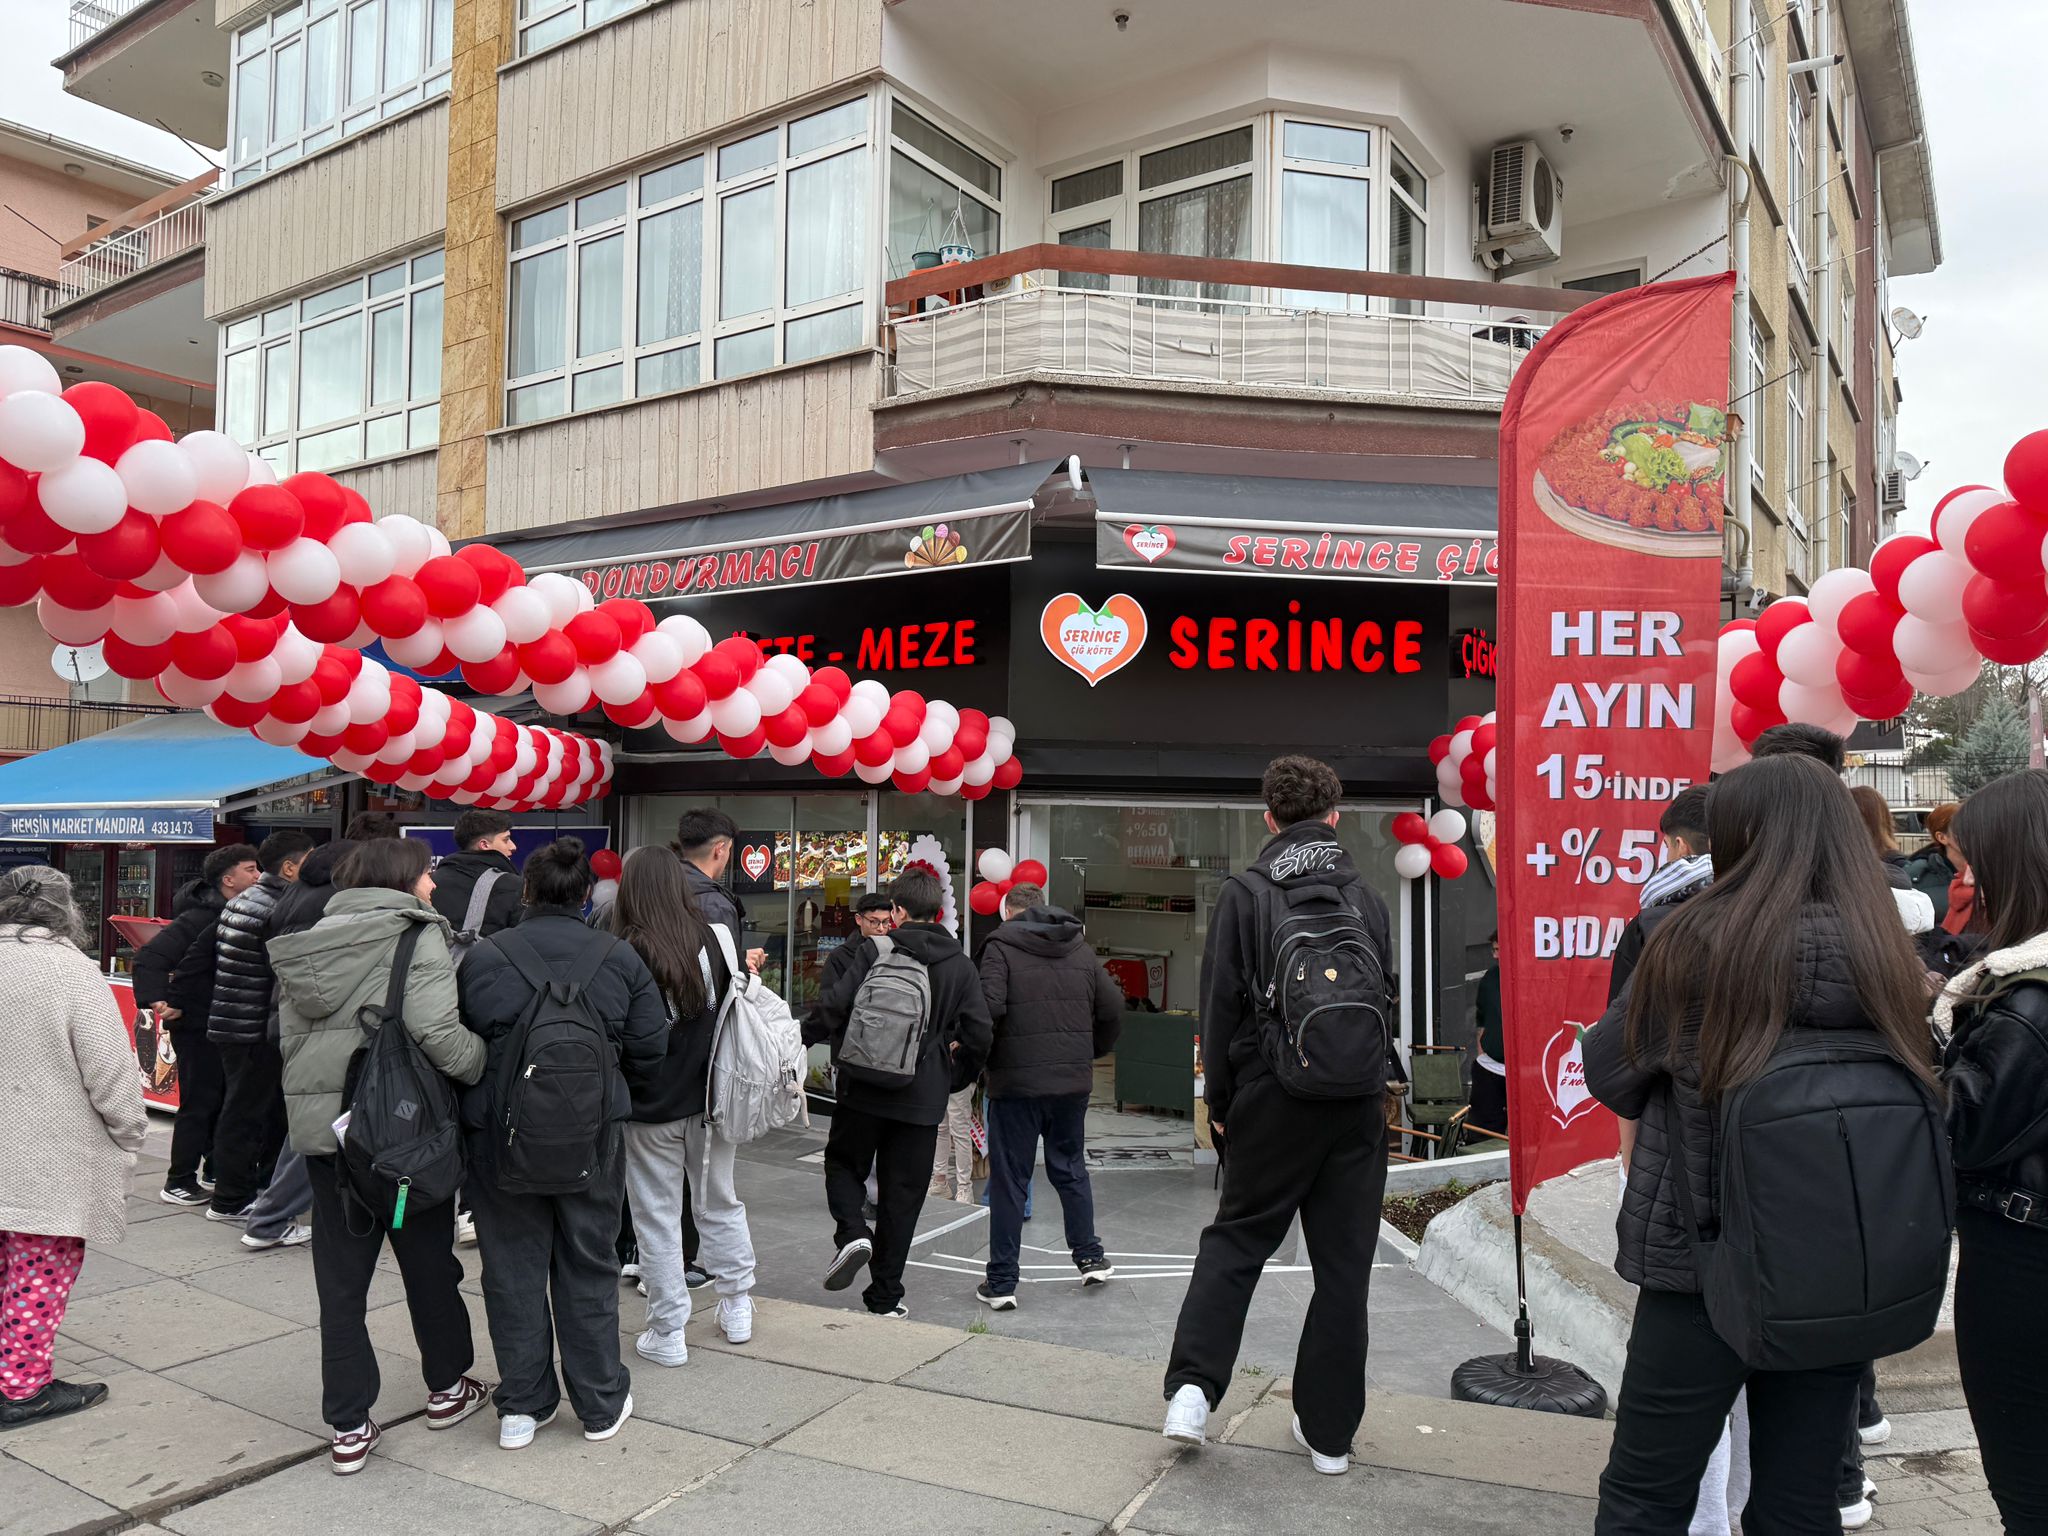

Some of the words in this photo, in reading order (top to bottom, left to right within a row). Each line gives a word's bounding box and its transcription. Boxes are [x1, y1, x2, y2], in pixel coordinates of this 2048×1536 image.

[582, 542, 820, 598] DONDURMACI
[1223, 533, 1421, 572] SERİNCE
[856, 619, 976, 671] MEZE
[1064, 626, 1122, 643] SERİNCE
[1071, 644, 1084, 656] ÇİĞ
[1087, 644, 1114, 656] KÖFTE
[1168, 600, 1423, 674] SERİNCE
[1551, 611, 1684, 657] HER
[1540, 683, 1696, 729] AYIN
[11, 814, 50, 838] HEMŞİN
[52, 817, 93, 834] MARKET
[95, 817, 145, 834] MANDIRA
[151, 821, 168, 834] 433
[170, 821, 181, 834] 14
[182, 821, 193, 834] 73
